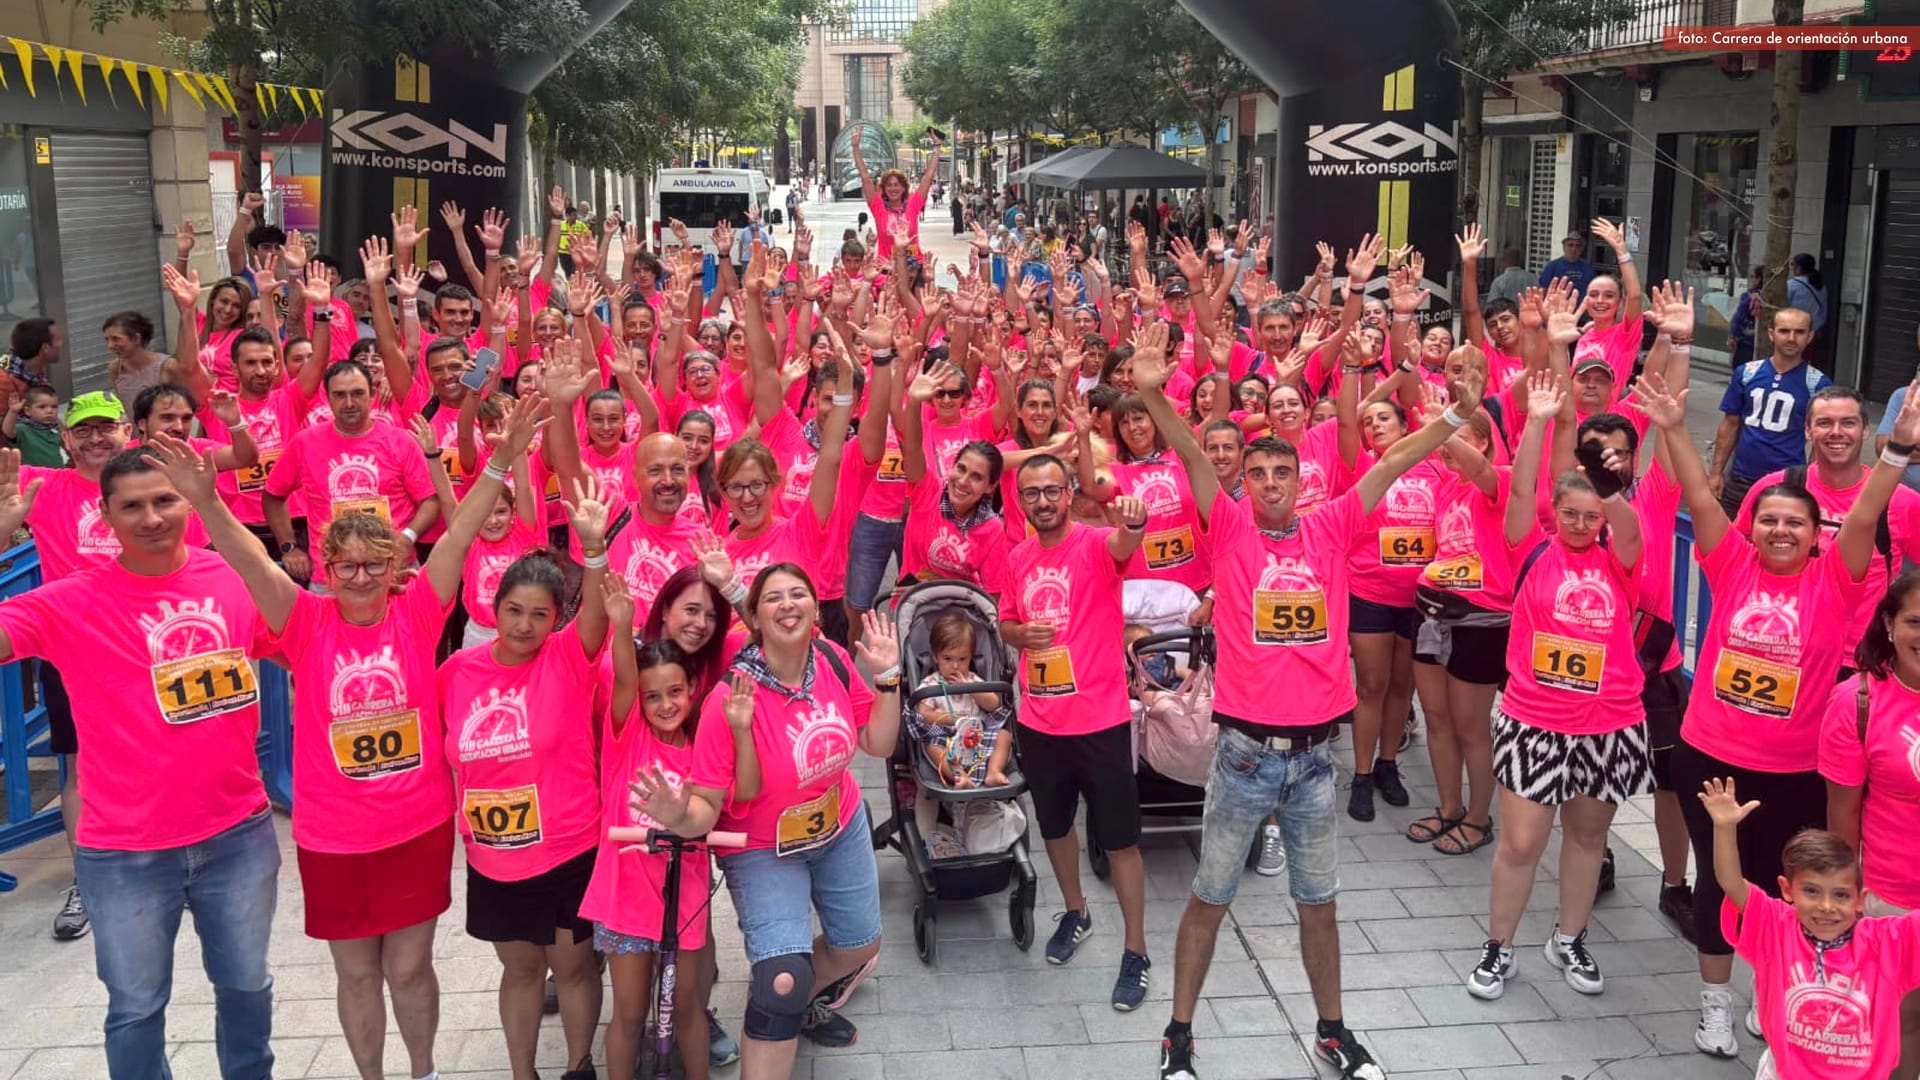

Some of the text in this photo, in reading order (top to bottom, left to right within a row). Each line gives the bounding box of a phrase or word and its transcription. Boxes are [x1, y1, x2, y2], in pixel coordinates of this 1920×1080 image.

[329, 108, 507, 164] KON
[1304, 119, 1459, 162] KON
[331, 152, 506, 179] www.konsports.com
[673, 179, 736, 188] AMBULANCIA
[1745, 387, 1795, 432] 10
[1155, 539, 1184, 558] 73
[1393, 538, 1424, 555] 64
[1272, 605, 1315, 630] 59
[1034, 663, 1047, 684] 7
[1547, 649, 1587, 677] 16
[166, 664, 243, 706] 111
[1730, 668, 1778, 702] 52
[352, 730, 403, 763] 80
[470, 802, 531, 833] 107
[806, 811, 825, 834] 3
[1804, 1025, 1859, 1046] CARRERA
